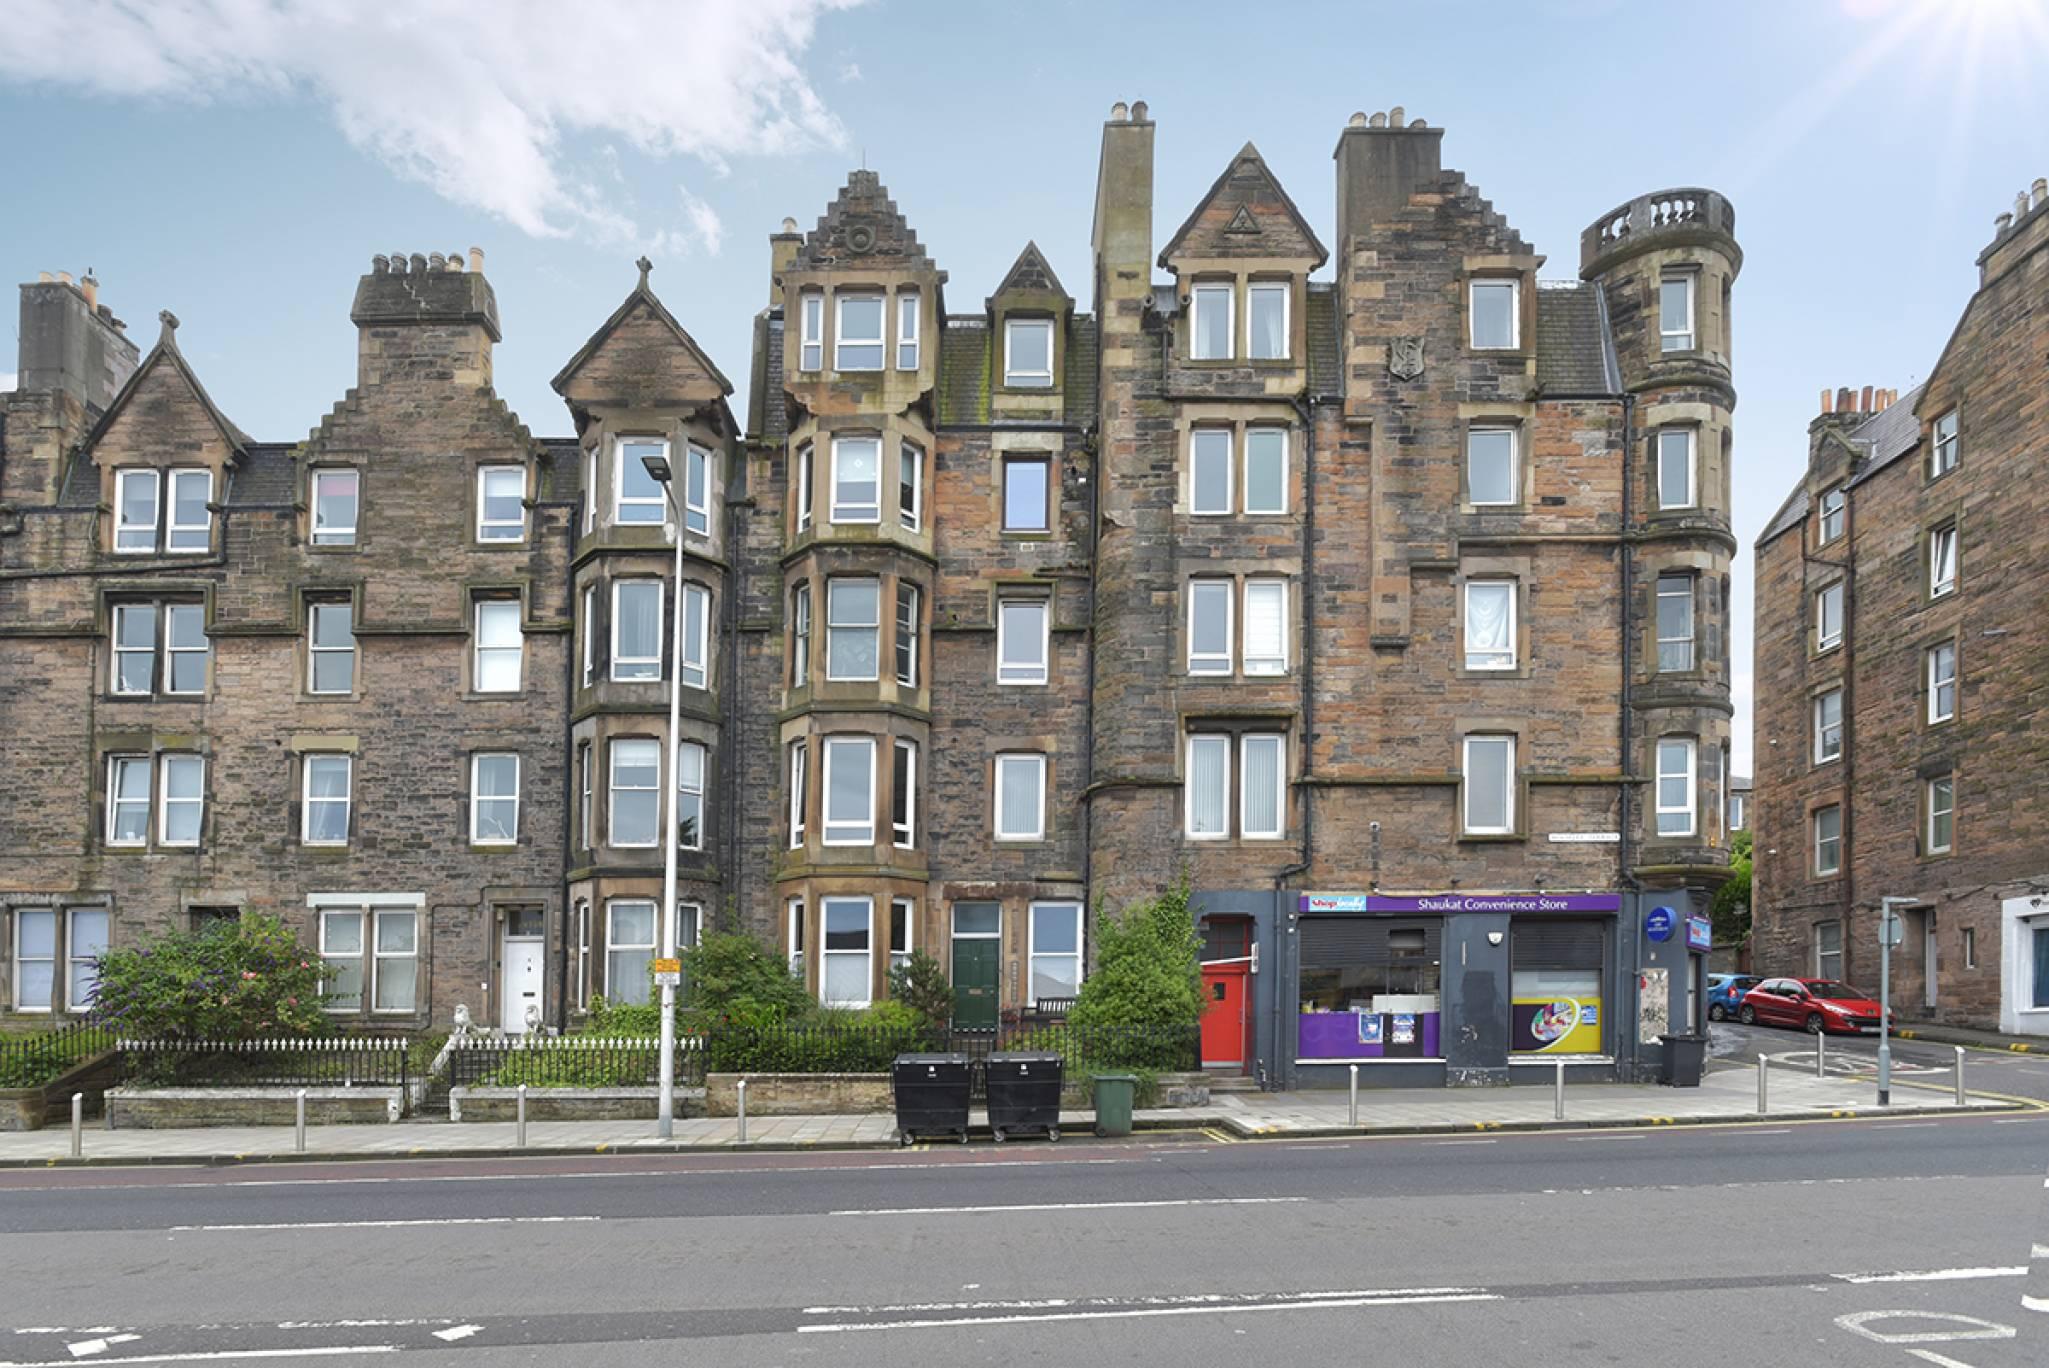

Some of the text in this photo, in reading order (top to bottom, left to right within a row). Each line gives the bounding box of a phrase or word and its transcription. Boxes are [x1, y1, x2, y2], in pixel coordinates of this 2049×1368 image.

[1418, 898, 1568, 910] Shaukat Convenience Store
